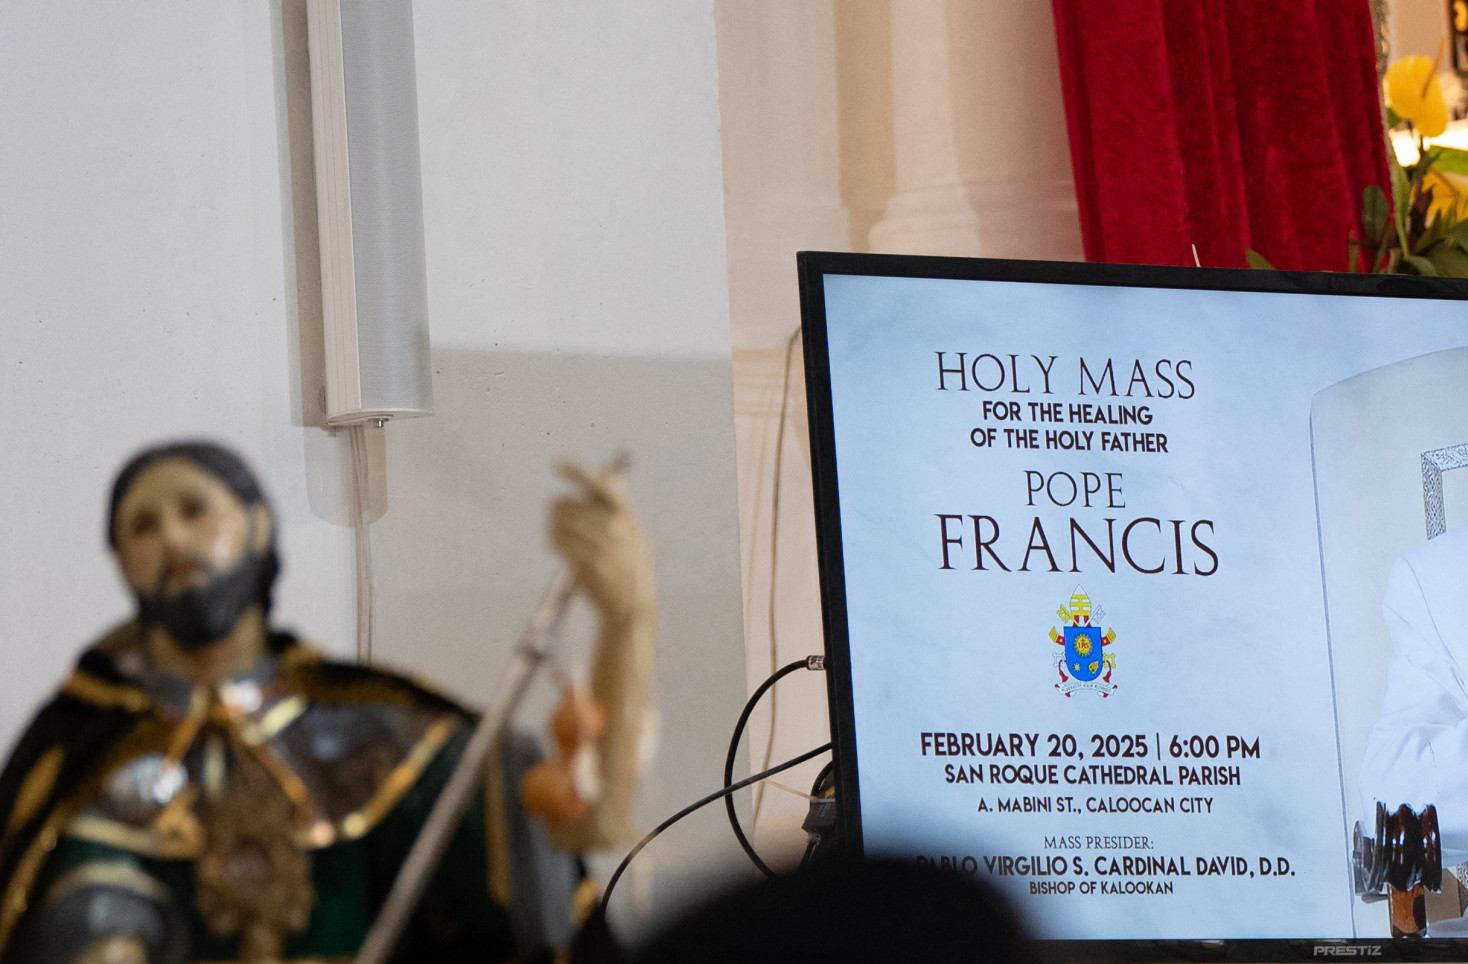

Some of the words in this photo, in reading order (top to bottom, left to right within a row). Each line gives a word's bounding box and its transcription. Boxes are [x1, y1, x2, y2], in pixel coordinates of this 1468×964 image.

[935, 351, 1059, 395] HOLY
[1078, 357, 1195, 400] MASS
[982, 400, 1022, 422] FOR
[1027, 401, 1064, 423] THE
[1068, 403, 1153, 426] HEALING
[970, 427, 997, 448] OF
[1002, 428, 1039, 450] THE
[1044, 429, 1095, 451] HOLY
[1100, 431, 1169, 454] FATHER
[1023, 470, 1126, 509] POPE
[935, 513, 1219, 577] FRANCIS
[920, 732, 1040, 757] FEBRUARY
[1046, 733, 1084, 761] 20,
[1090, 734, 1149, 758] 2025
[1168, 734, 1220, 759] 6:00
[1226, 735, 1261, 759] PM
[944, 763, 983, 784] SAN
[989, 764, 1059, 785] ROQUE
[1063, 765, 1173, 786] CATHEDRAL
[1178, 766, 1241, 786] PARISH
[977, 797, 993, 813] A.
[997, 796, 1052, 813] MABINI
[1056, 797, 1082, 815] ST.,
[1085, 797, 1175, 814] CALOOCAN
[1179, 797, 1214, 814] CITY
[1044, 835, 1082, 850] MASS
[1085, 836, 1155, 850] PRESIDER:
[983, 855, 1068, 876] VIRGILIO
[1072, 855, 1089, 877] S.
[1093, 855, 1192, 877] CARDINAL
[1195, 856, 1255, 879] DAVID,
[1258, 856, 1296, 877] D.D.
[1029, 881, 1076, 895] BISHOP
[1078, 881, 1098, 895] OF
[1100, 881, 1174, 895] KALOOKAN
